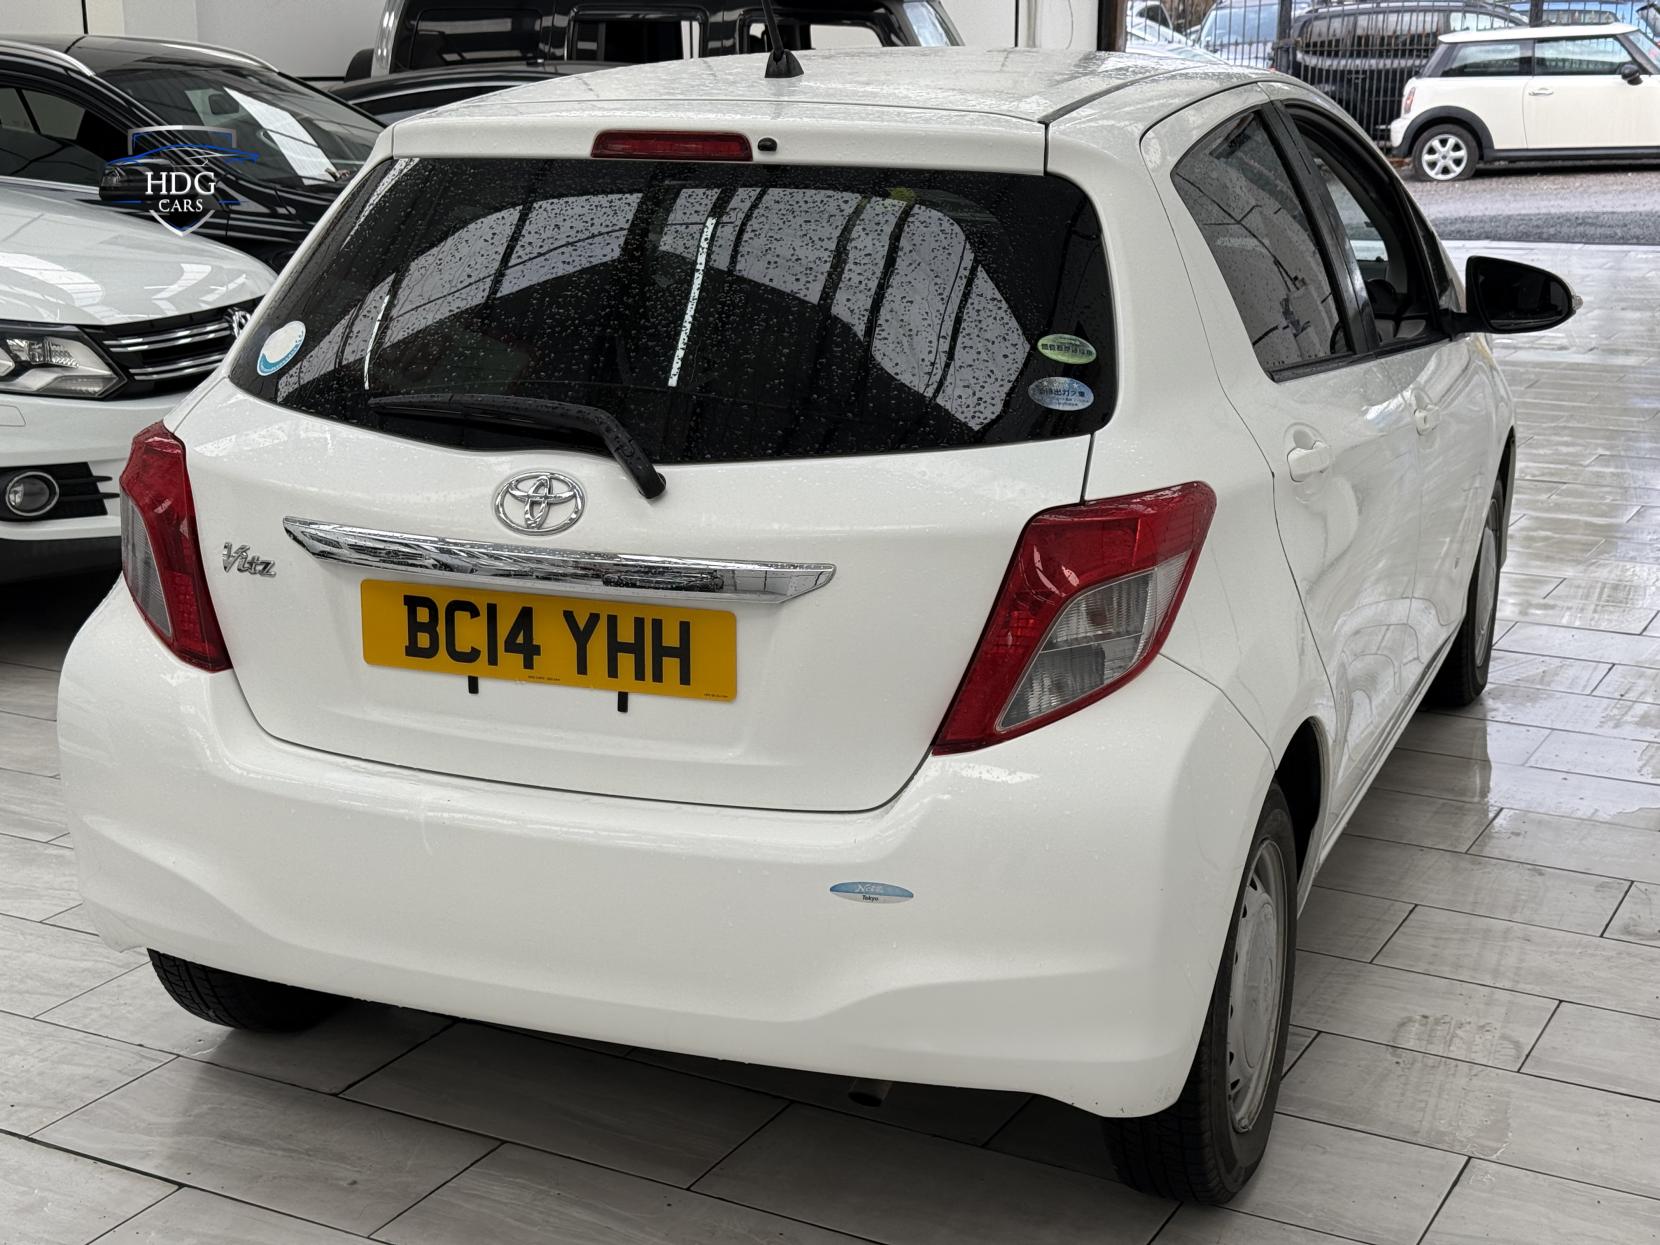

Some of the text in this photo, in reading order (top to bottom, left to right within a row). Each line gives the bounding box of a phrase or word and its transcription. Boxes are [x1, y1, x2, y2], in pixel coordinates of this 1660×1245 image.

[222, 541, 277, 578] Vitz
[403, 594, 691, 686] BC14 YHH
[862, 894, 879, 903] Tokyo
